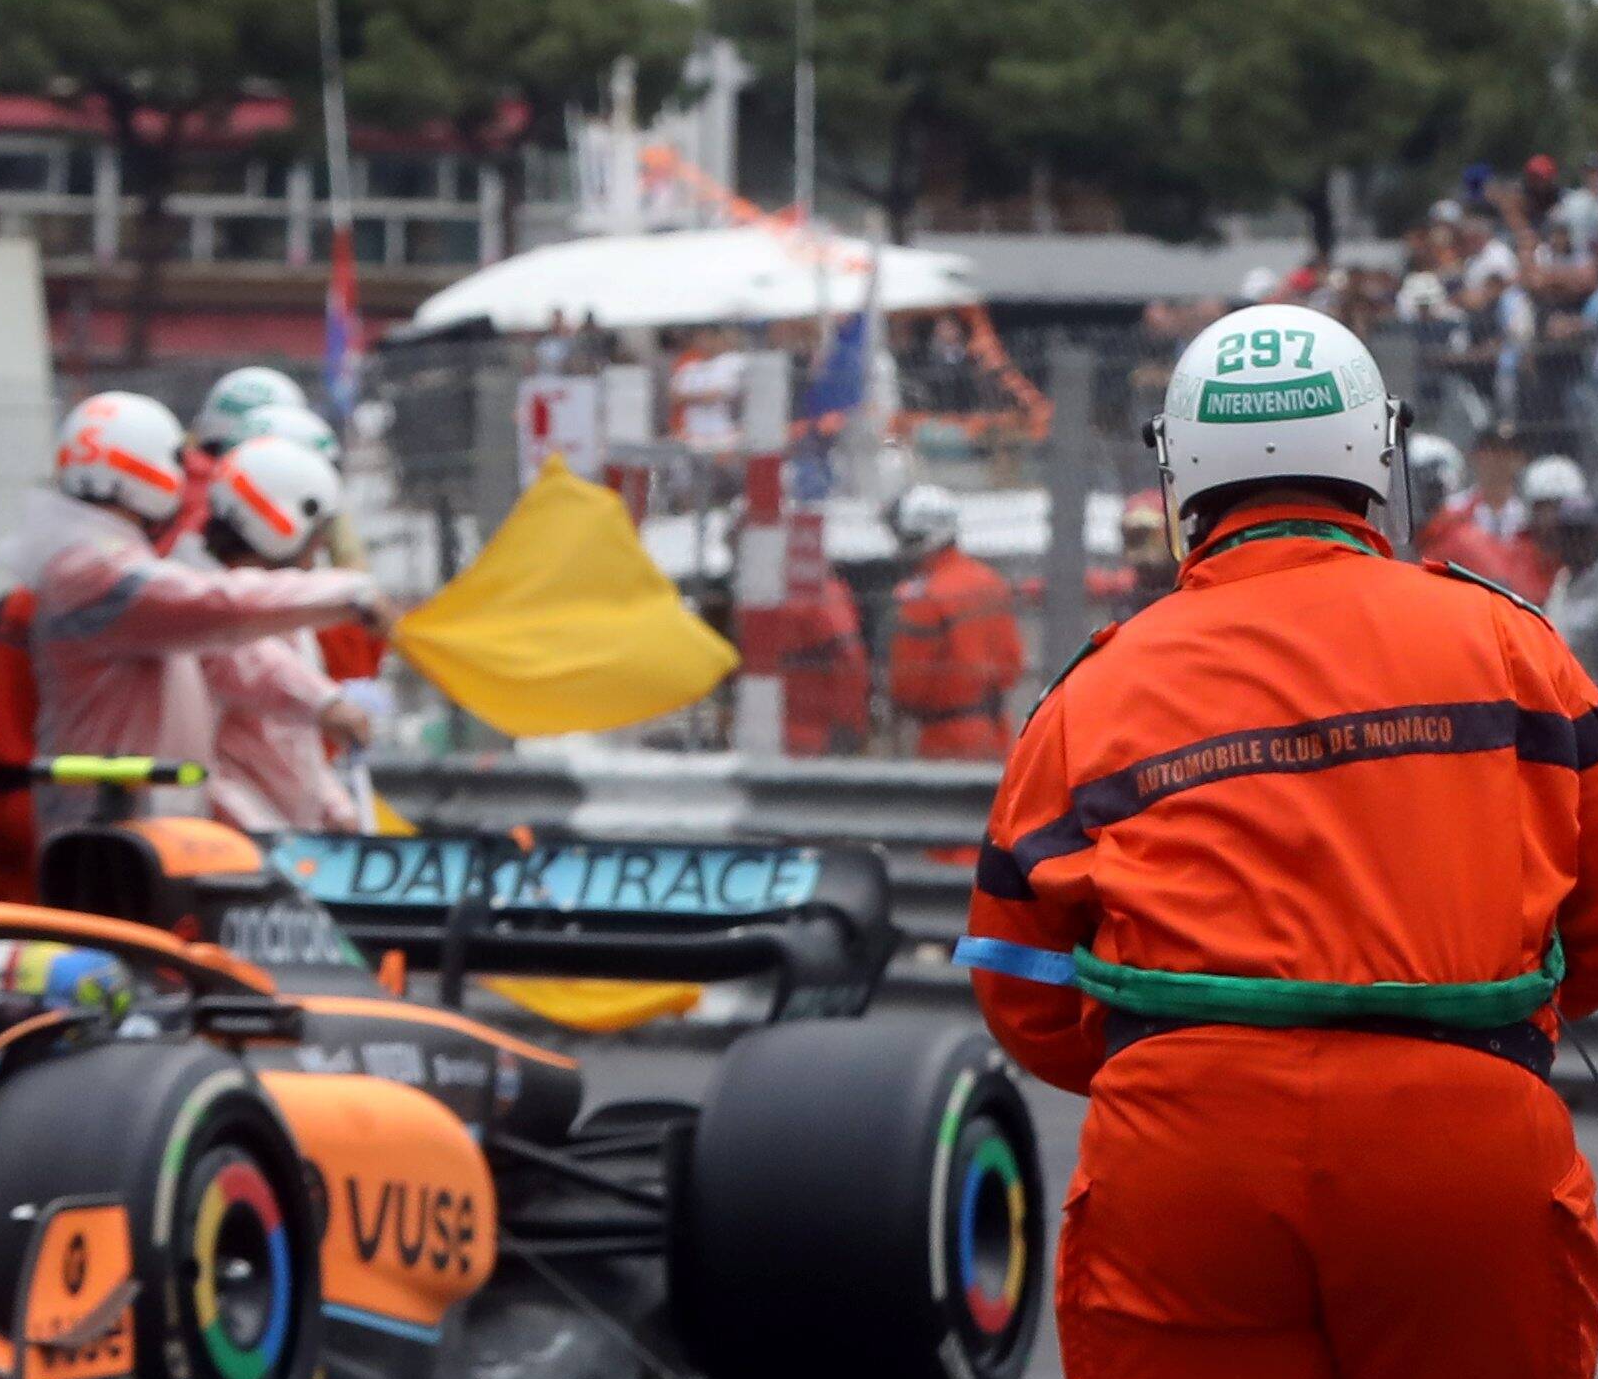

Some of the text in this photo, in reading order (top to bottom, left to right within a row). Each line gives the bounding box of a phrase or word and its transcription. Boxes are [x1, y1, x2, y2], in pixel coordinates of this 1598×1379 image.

[1216, 328, 1317, 375] 297
[1208, 385, 1333, 415] INTERVENTION
[1134, 715, 1453, 799] AUTOMOBILE CLUB DE MONACO
[348, 835, 804, 908] DARKTRACE
